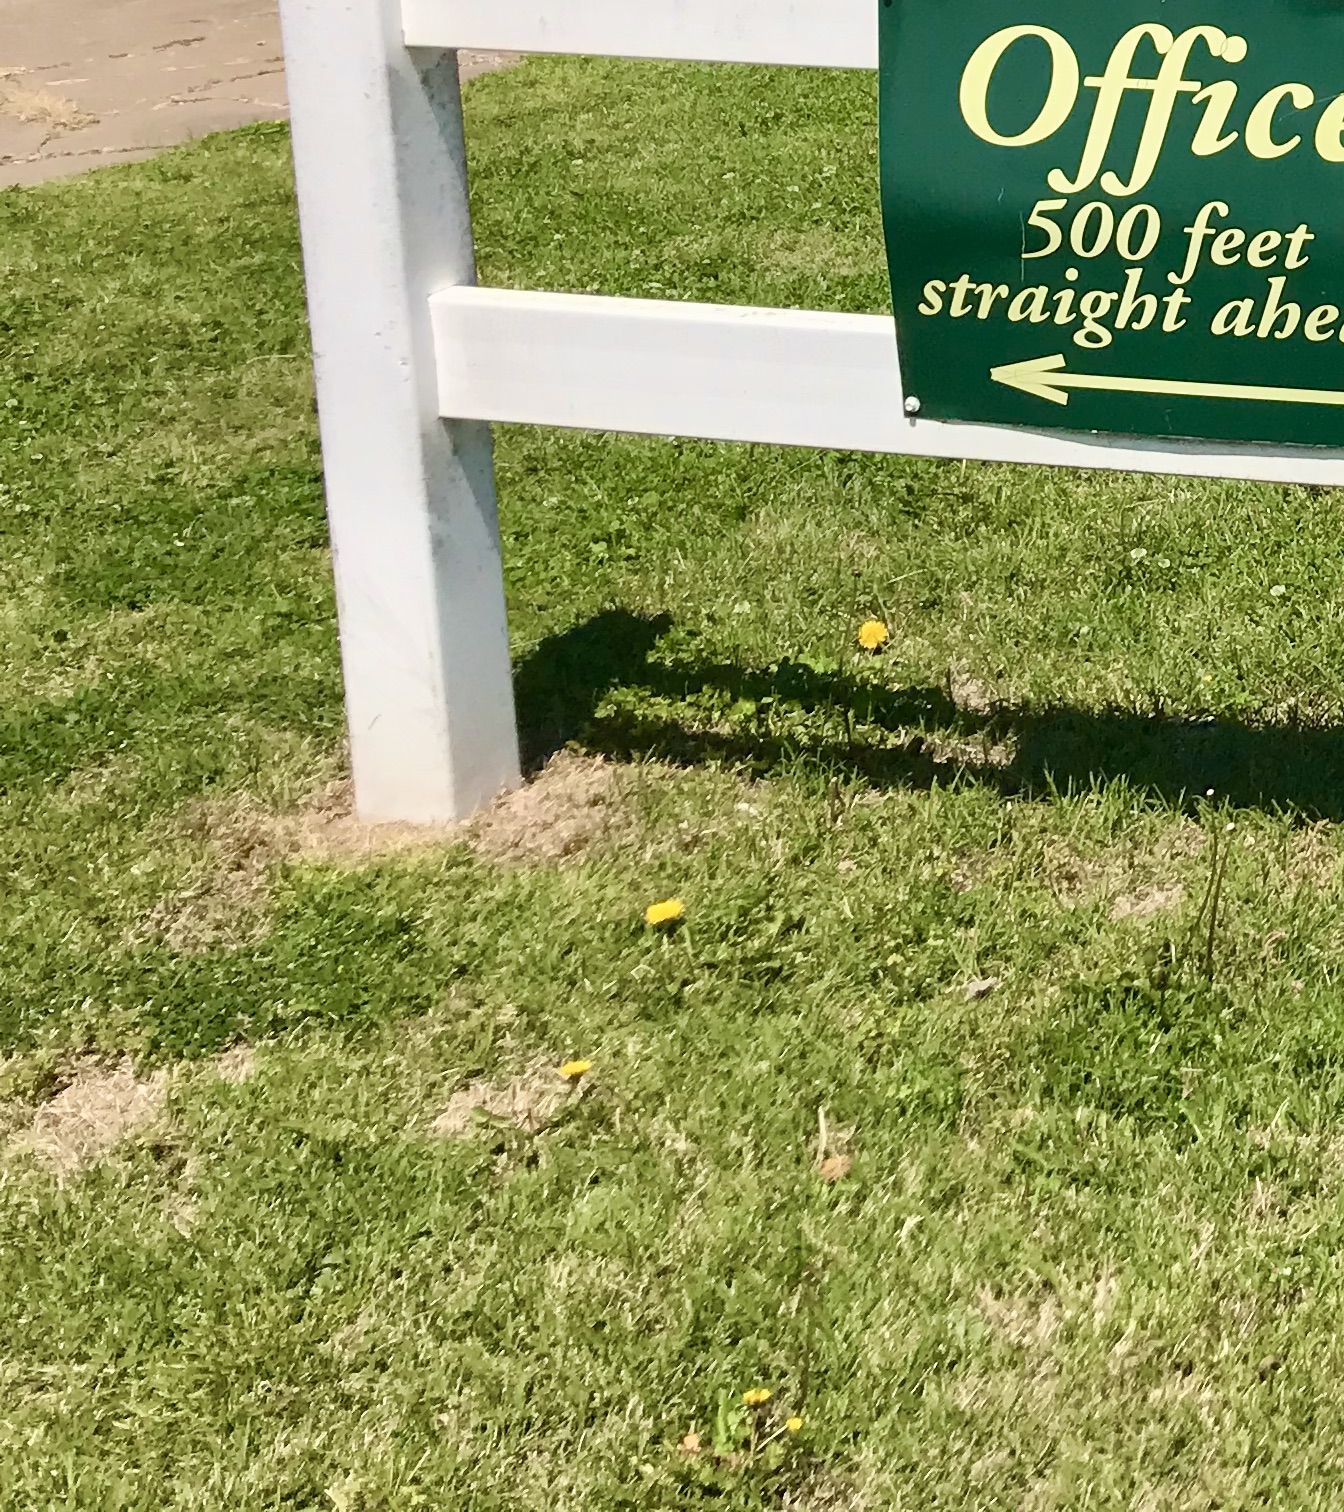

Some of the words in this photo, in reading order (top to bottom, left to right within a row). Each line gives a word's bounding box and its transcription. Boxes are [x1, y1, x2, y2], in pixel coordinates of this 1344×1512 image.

[1021, 198, 1161, 261] 500
[1167, 201, 1315, 285] feet
[918, 267, 1192, 349] straight
